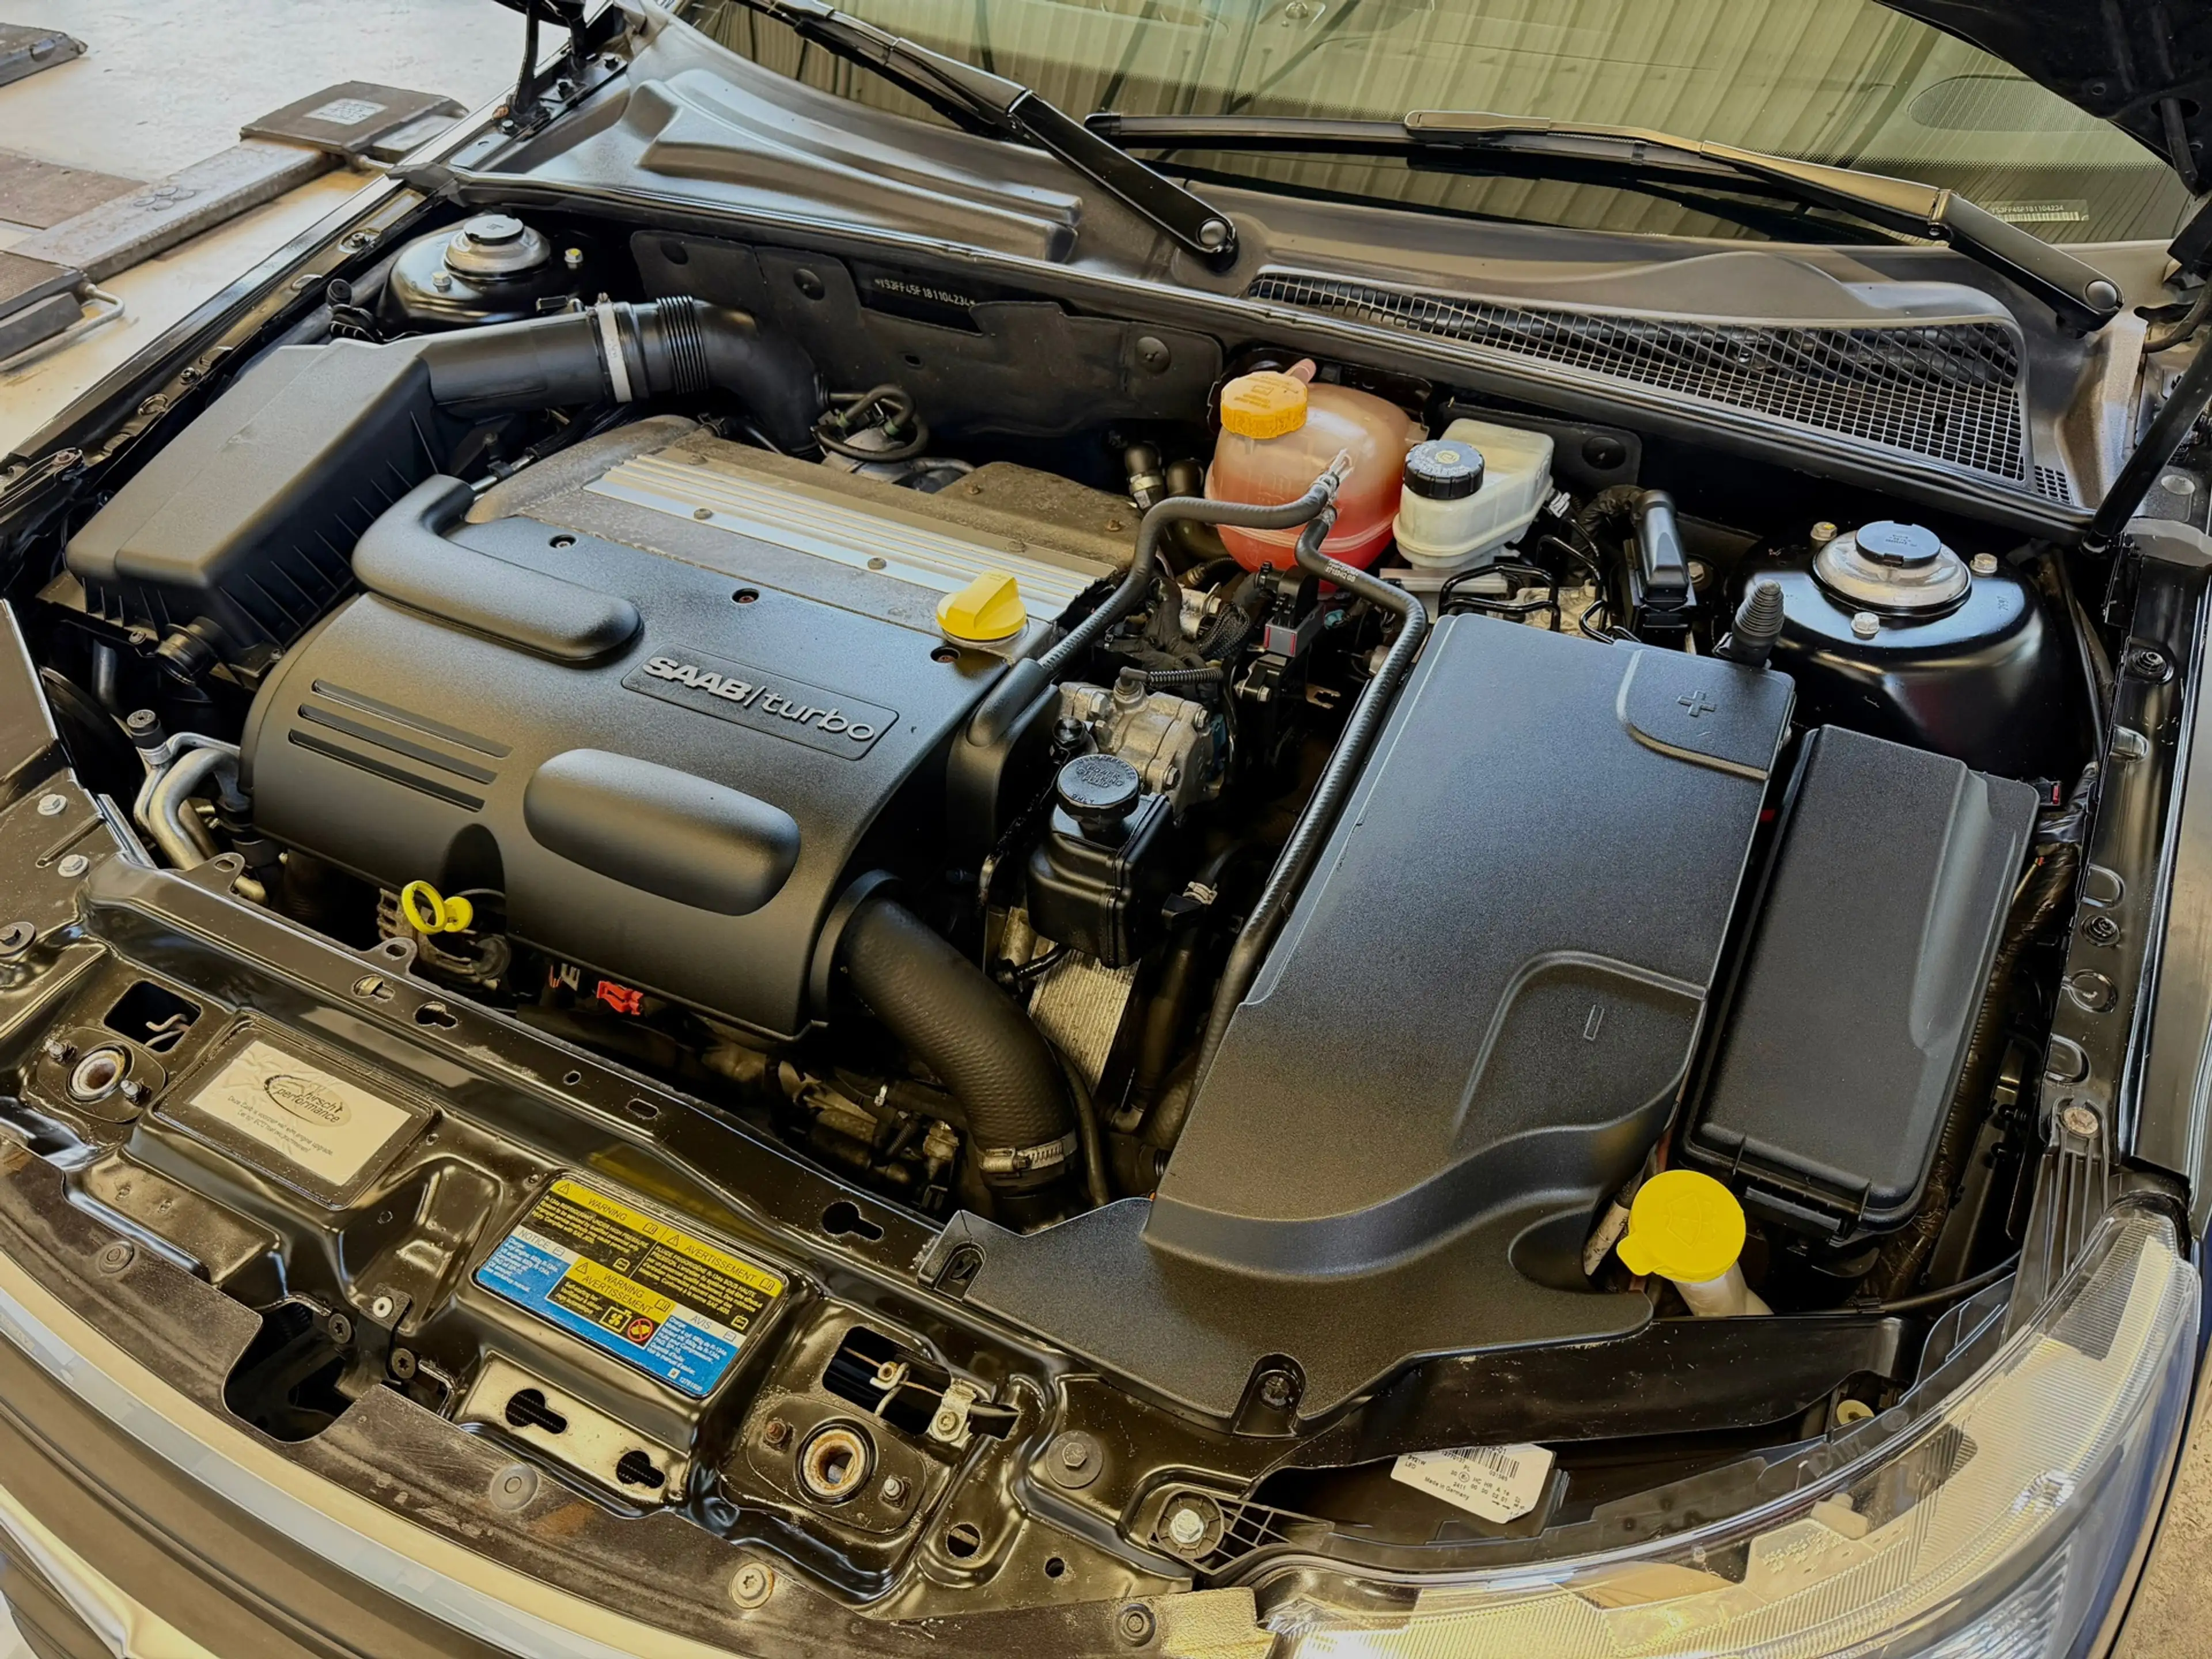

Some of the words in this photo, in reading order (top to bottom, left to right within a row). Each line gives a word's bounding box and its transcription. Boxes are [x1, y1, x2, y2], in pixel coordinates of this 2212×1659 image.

[274, 1088, 341, 1123] performance
[304, 1091, 339, 1113] hirsch
[586, 1199, 627, 1220] WARNING
[518, 1229, 551, 1249] NOTICE
[684, 1244, 757, 1282] AVERTISSEMENT
[582, 1274, 653, 1314] AVERTISSEMENT
[603, 1274, 645, 1298] WARNING
[691, 1315, 712, 1329] AVIS
[1423, 1476, 1440, 1486] Made
[1444, 1486, 1470, 1500] Germany
